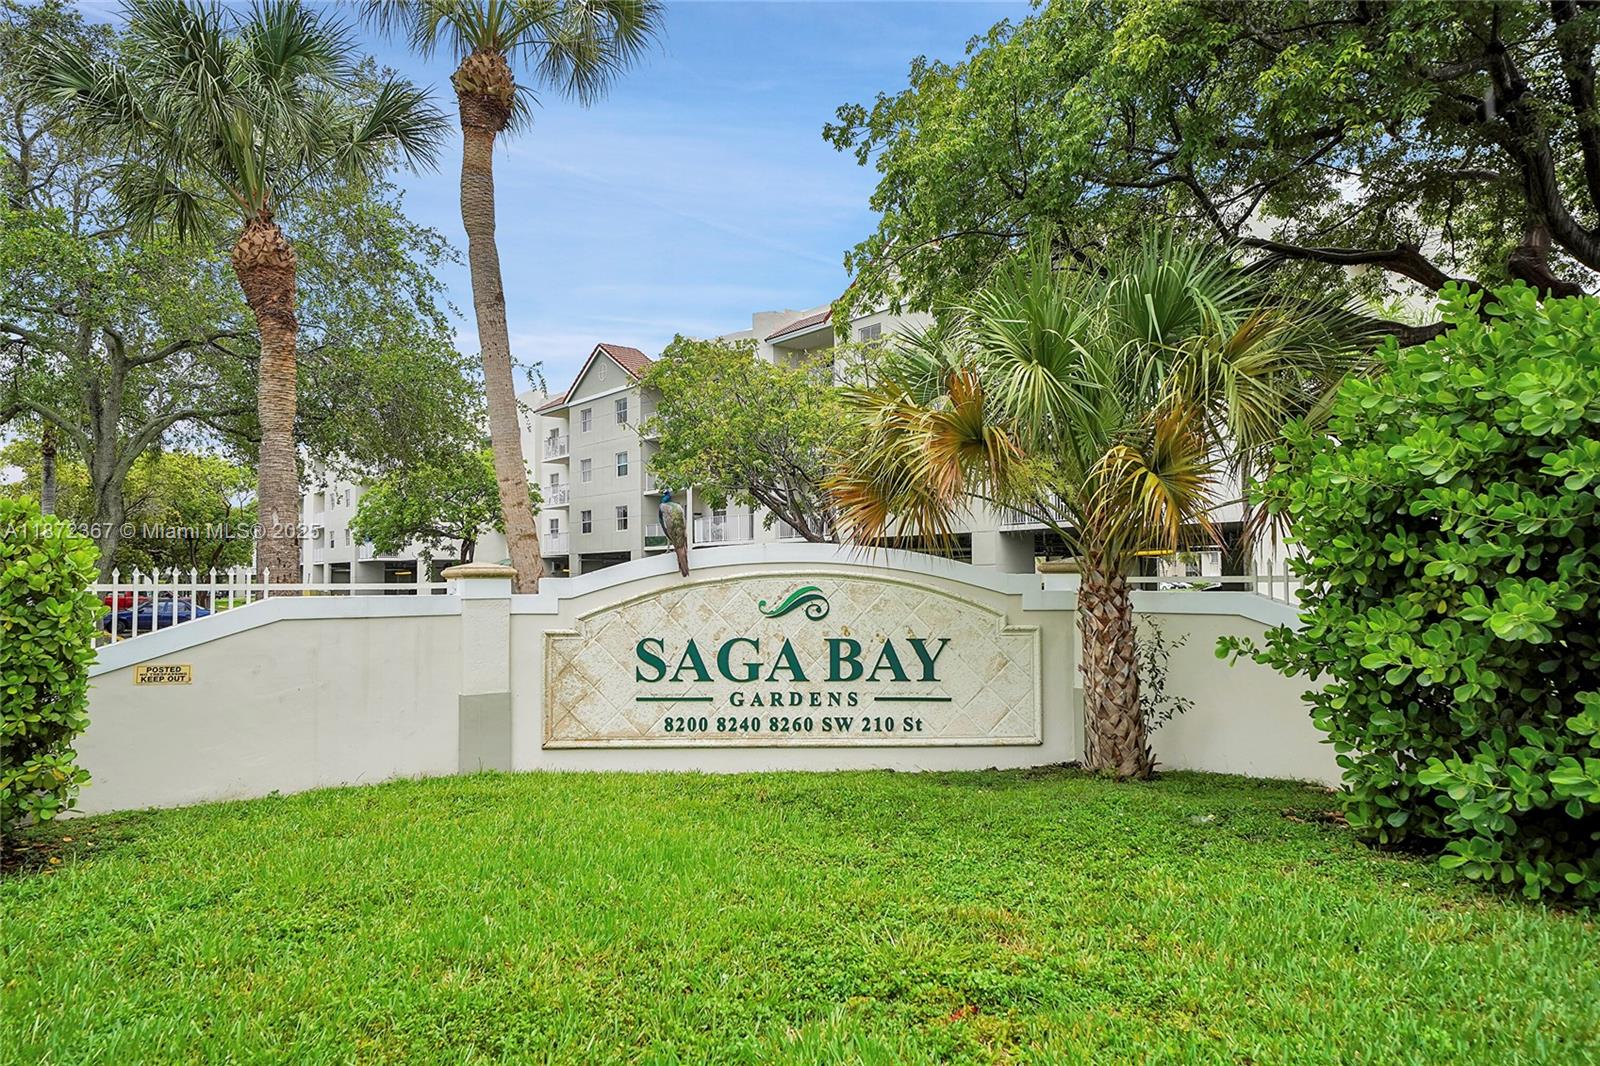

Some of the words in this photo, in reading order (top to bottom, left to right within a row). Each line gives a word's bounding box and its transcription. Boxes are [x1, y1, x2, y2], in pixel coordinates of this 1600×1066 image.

[636, 637, 810, 684] SAGA
[824, 637, 951, 683] BAY
[730, 691, 859, 707] GARDENS
[664, 716, 709, 732] 8200
[717, 716, 761, 732] 8240
[769, 716, 814, 732] 8260
[822, 716, 854, 732] SW
[862, 716, 895, 732] 210
[903, 716, 923, 732] St
